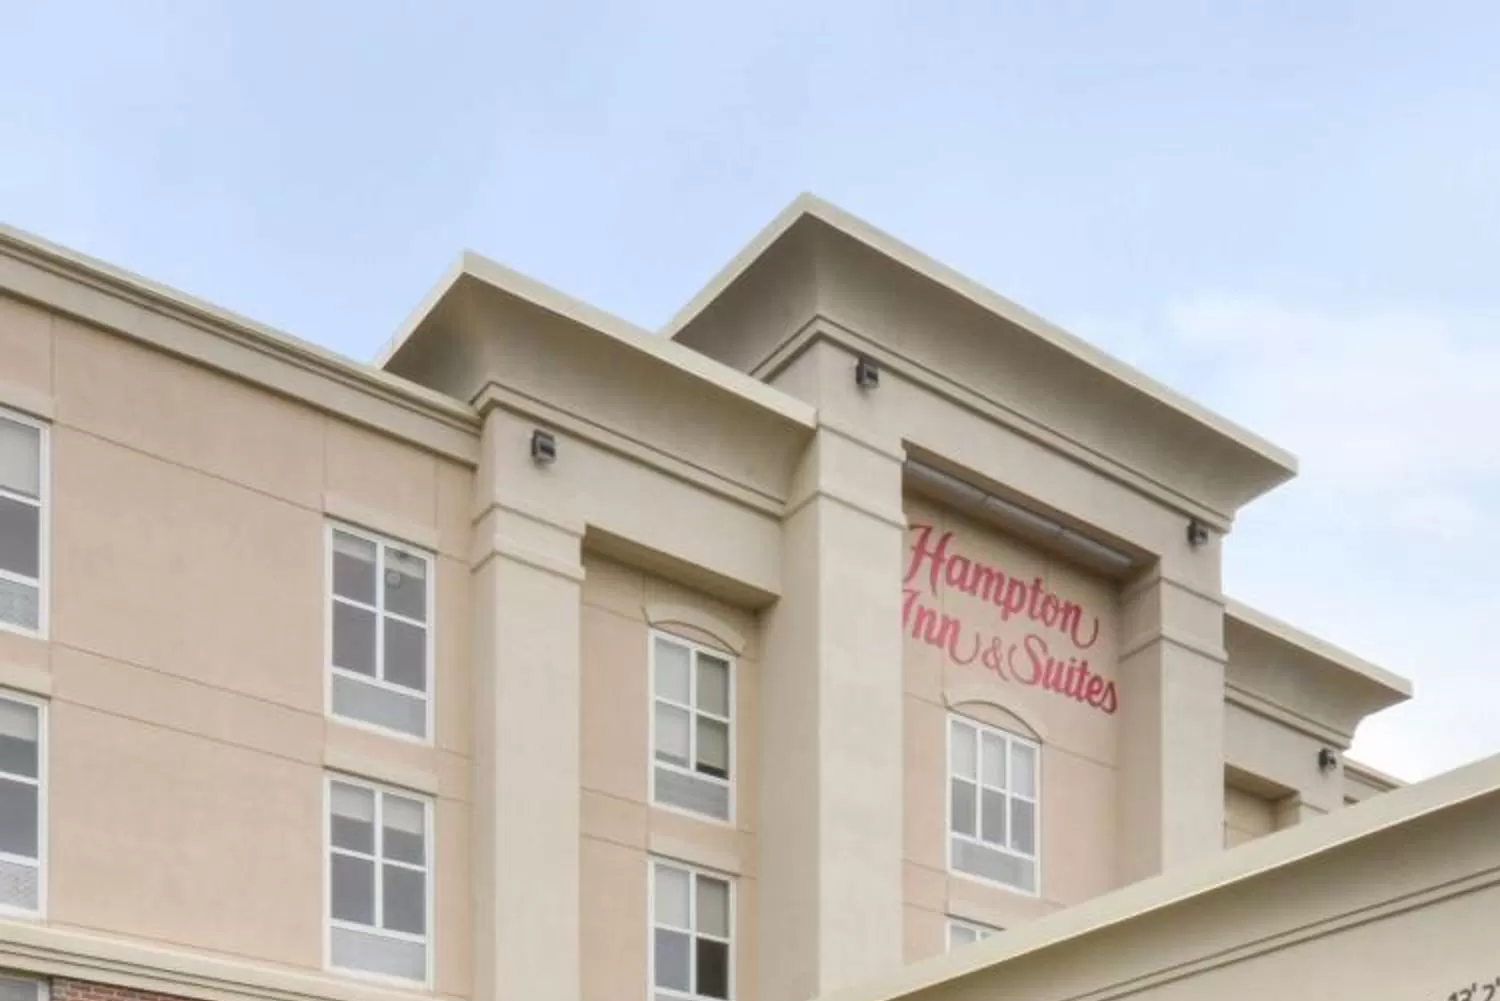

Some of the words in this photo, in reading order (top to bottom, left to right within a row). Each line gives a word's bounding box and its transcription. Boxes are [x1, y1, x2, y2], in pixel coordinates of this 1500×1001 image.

[903, 524, 1098, 649] Hampton
[981, 636, 1010, 682] &
[1007, 634, 1117, 714] Suites
